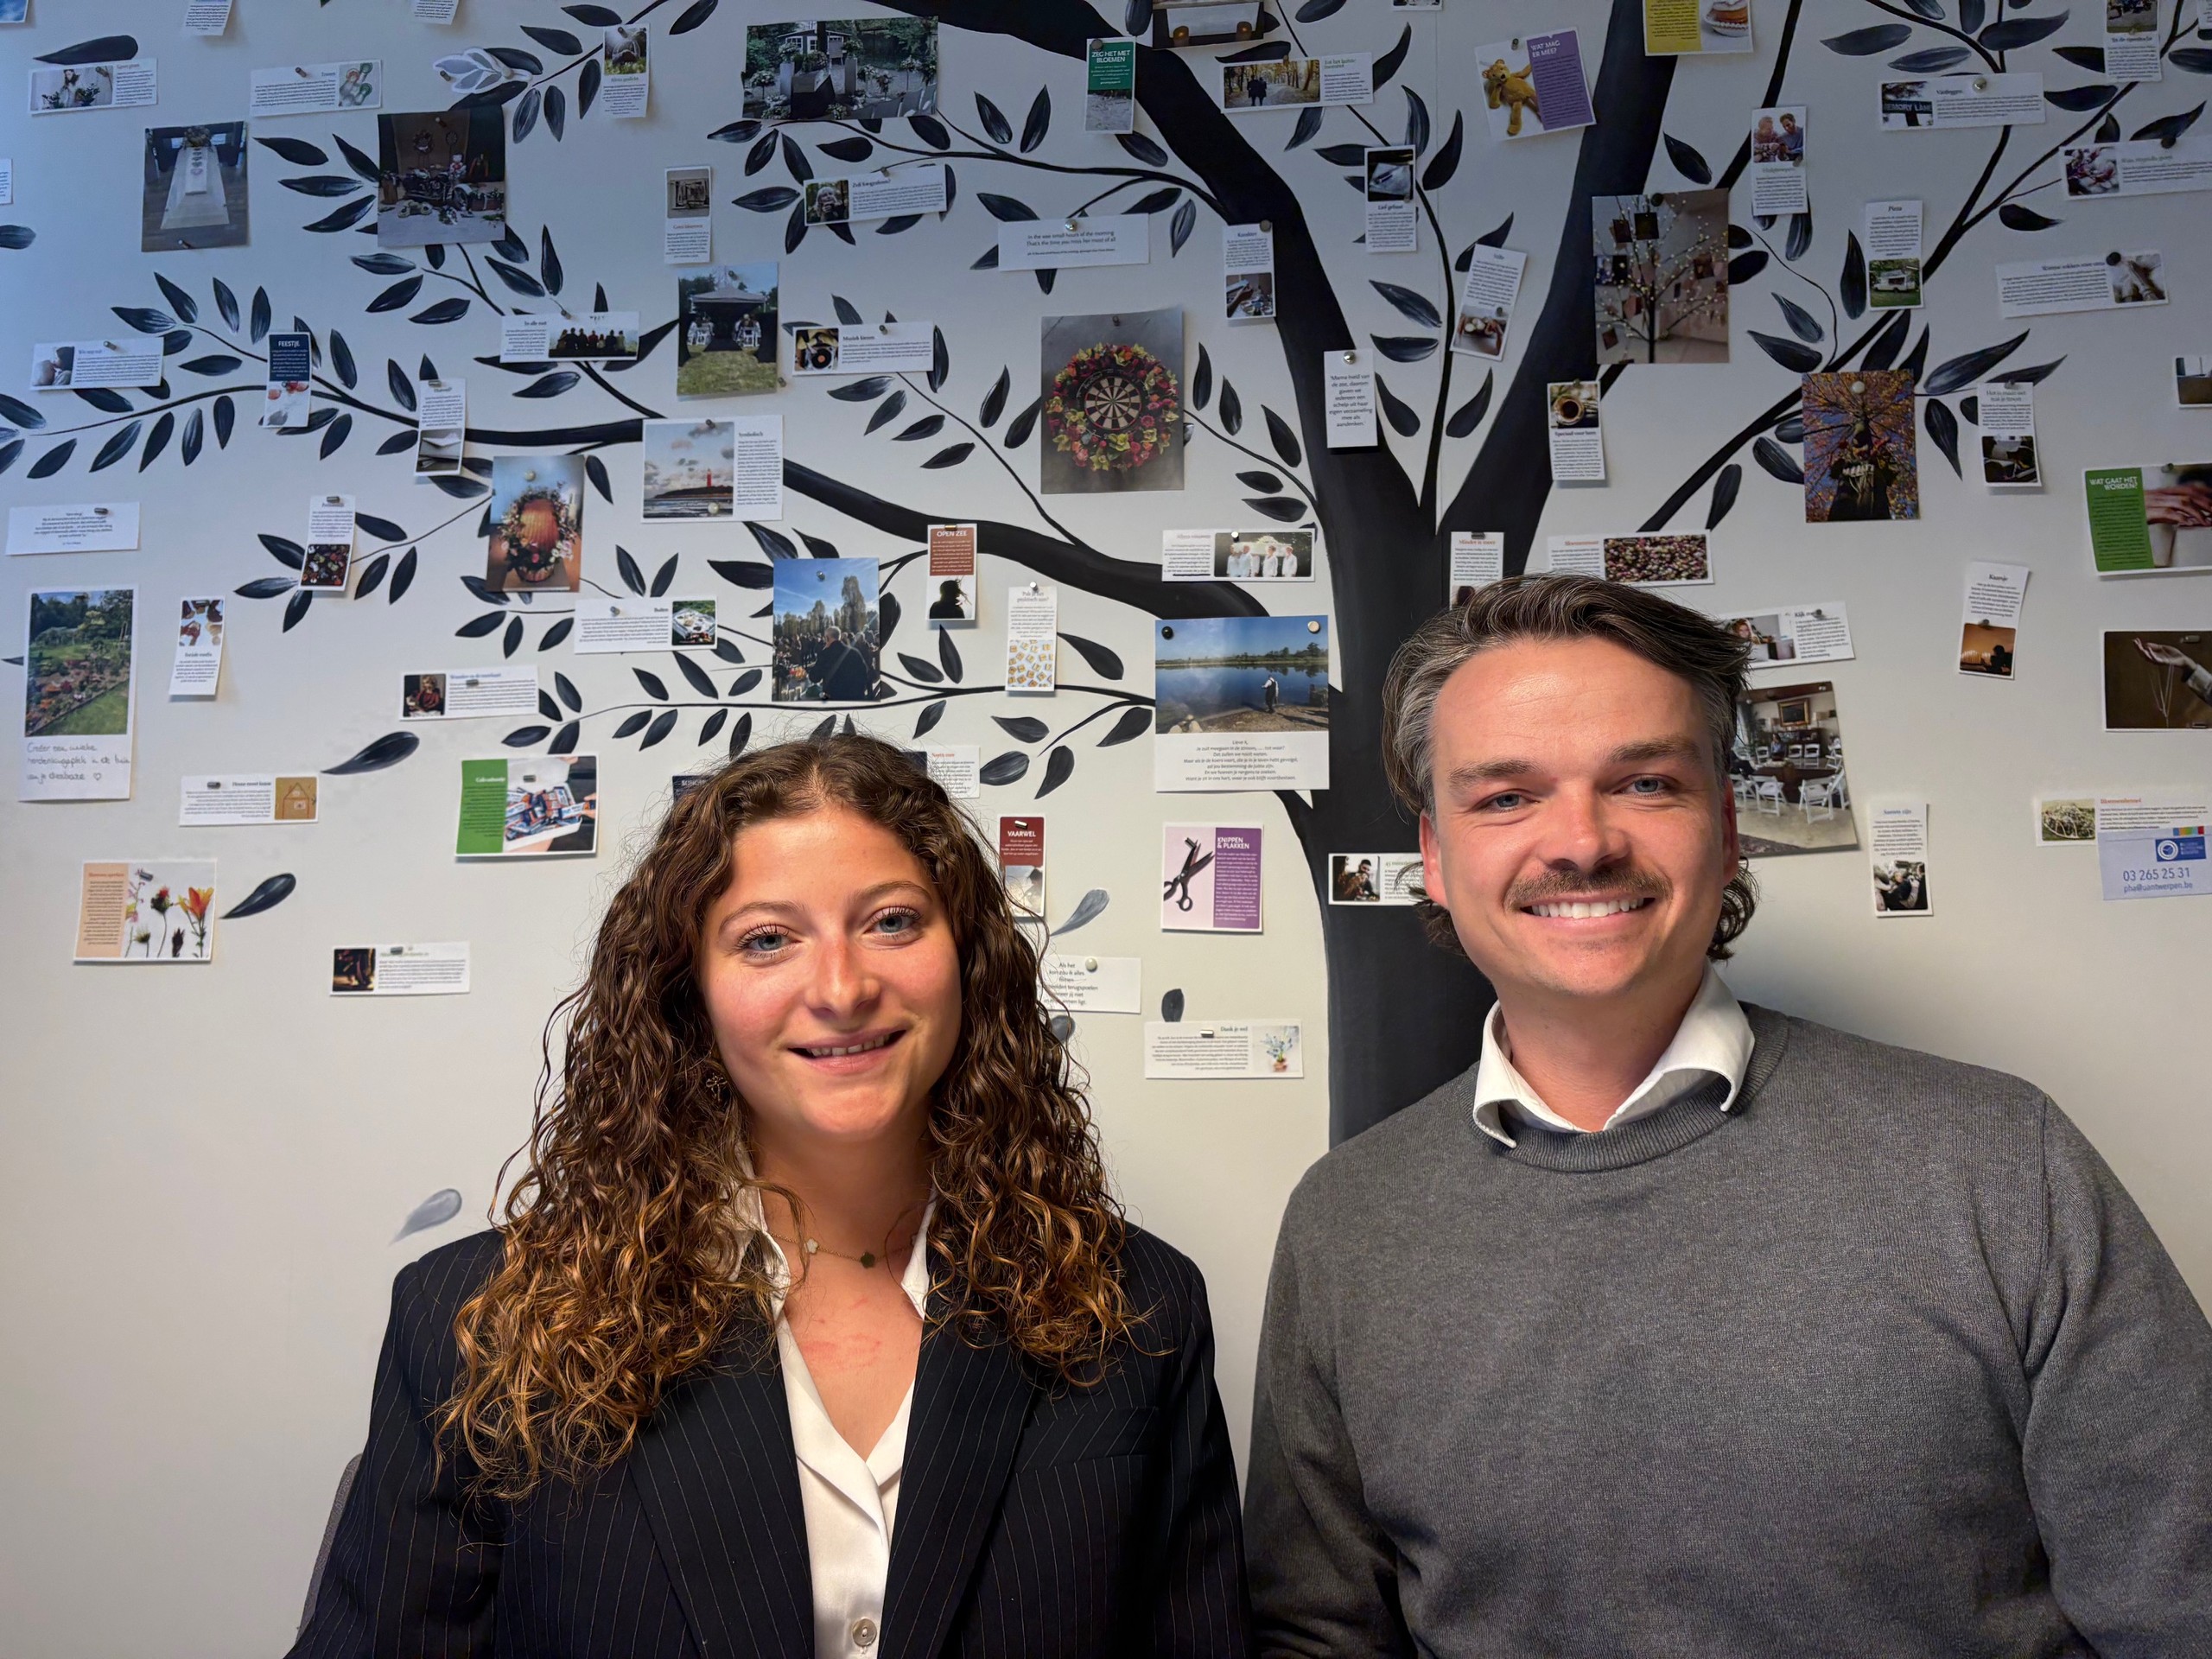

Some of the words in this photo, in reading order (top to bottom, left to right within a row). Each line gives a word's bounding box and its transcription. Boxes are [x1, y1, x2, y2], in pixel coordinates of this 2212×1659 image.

[1530, 43, 1544, 51] WAT
[1545, 40, 1560, 48] MAG
[2123, 871, 2136, 881] 03
[2139, 869, 2159, 881] 265
[2161, 868, 2175, 880] 25
[2177, 867, 2190, 878] 31
